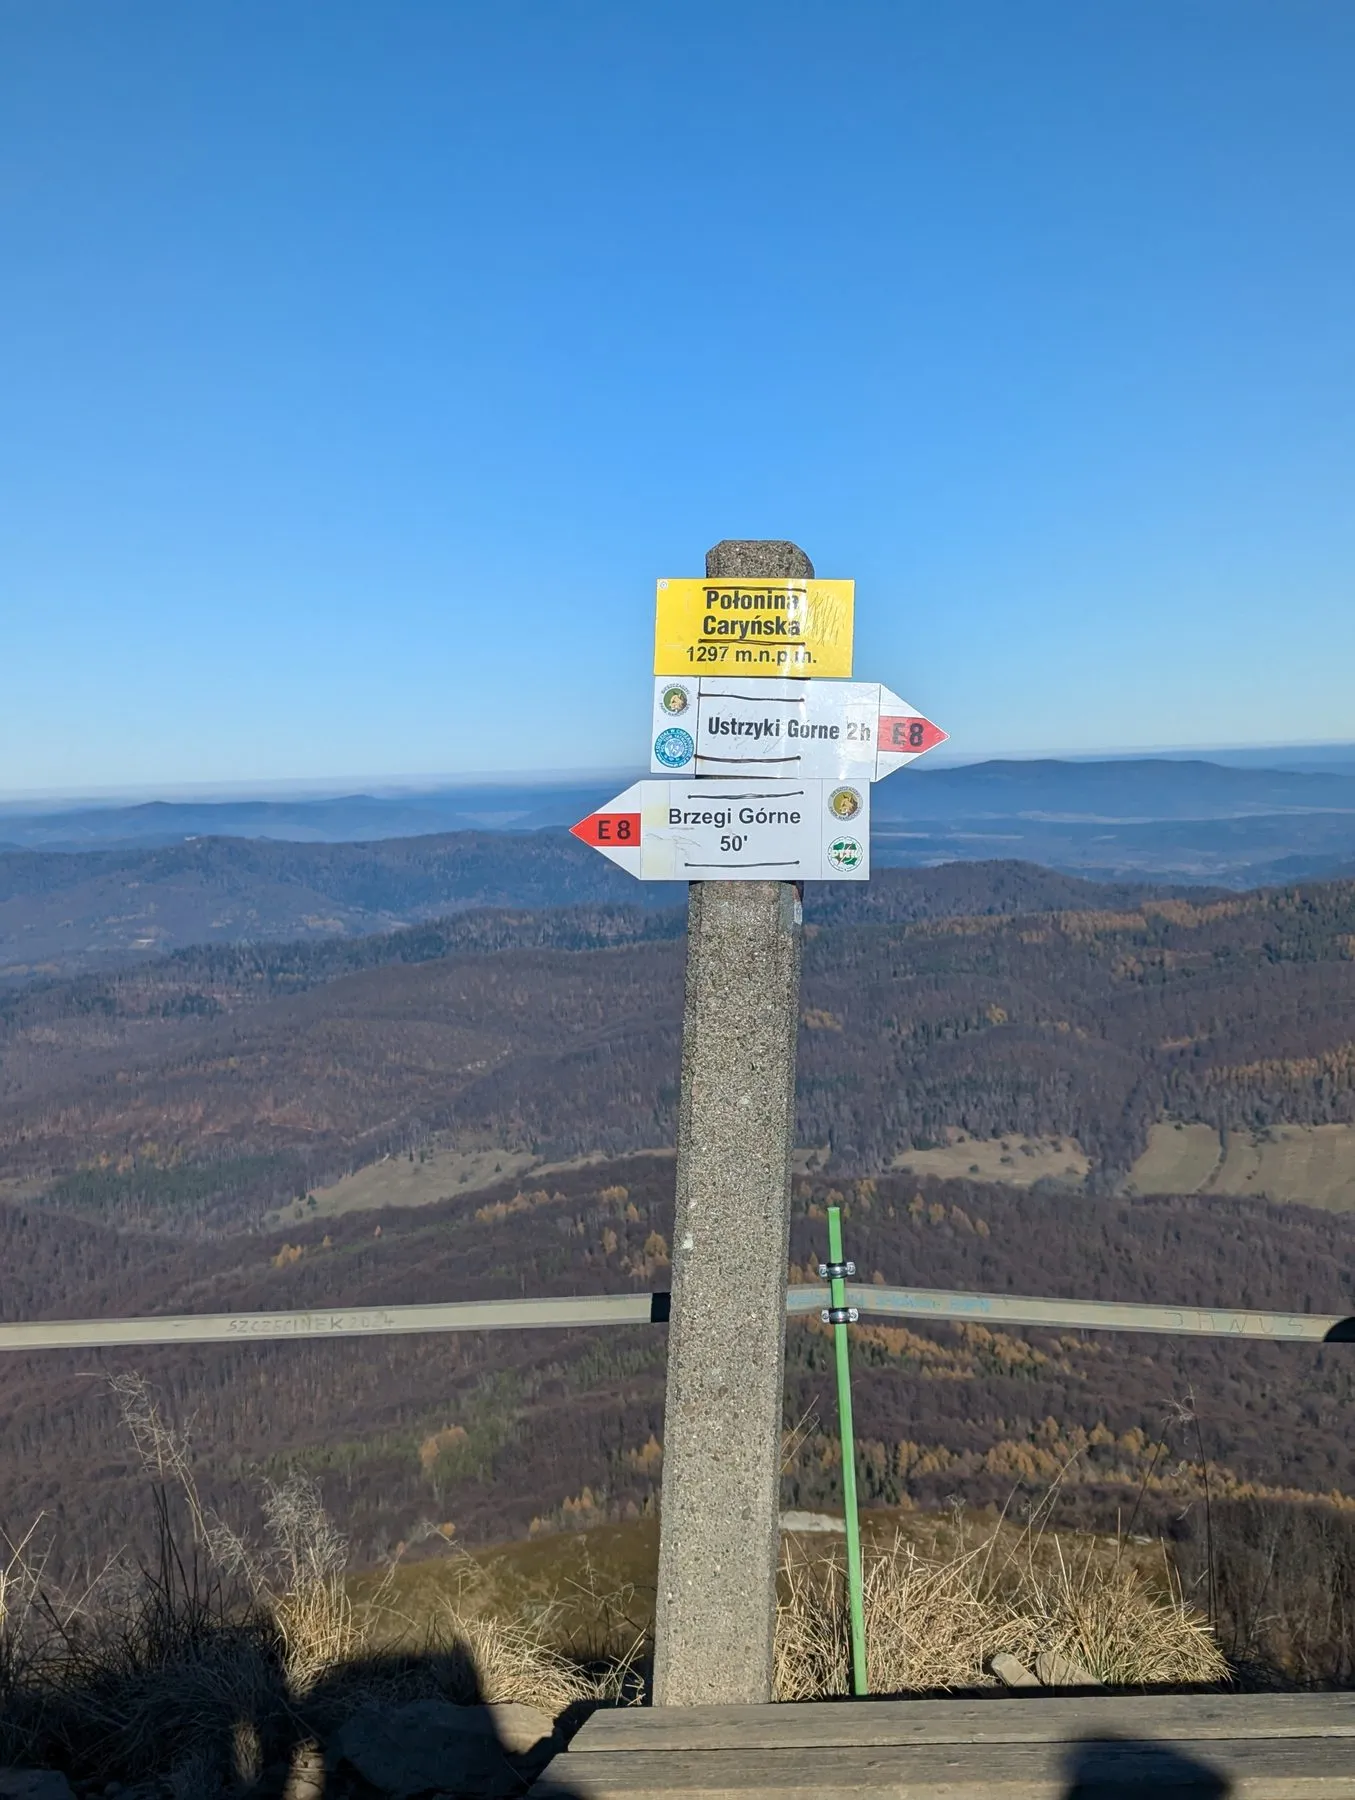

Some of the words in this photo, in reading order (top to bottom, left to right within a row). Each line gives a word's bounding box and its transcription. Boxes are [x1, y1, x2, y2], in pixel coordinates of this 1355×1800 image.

[706, 590, 800, 610] Połonina
[703, 615, 801, 639] Caryńska
[686, 646, 729, 662] 1297
[708, 717, 780, 740] Ustrzyki
[787, 718, 840, 740] Górne
[847, 722, 871, 742] 2h
[668, 808, 732, 828] Brzegi
[738, 806, 801, 825] Górne
[719, 835, 749, 852] 50'
